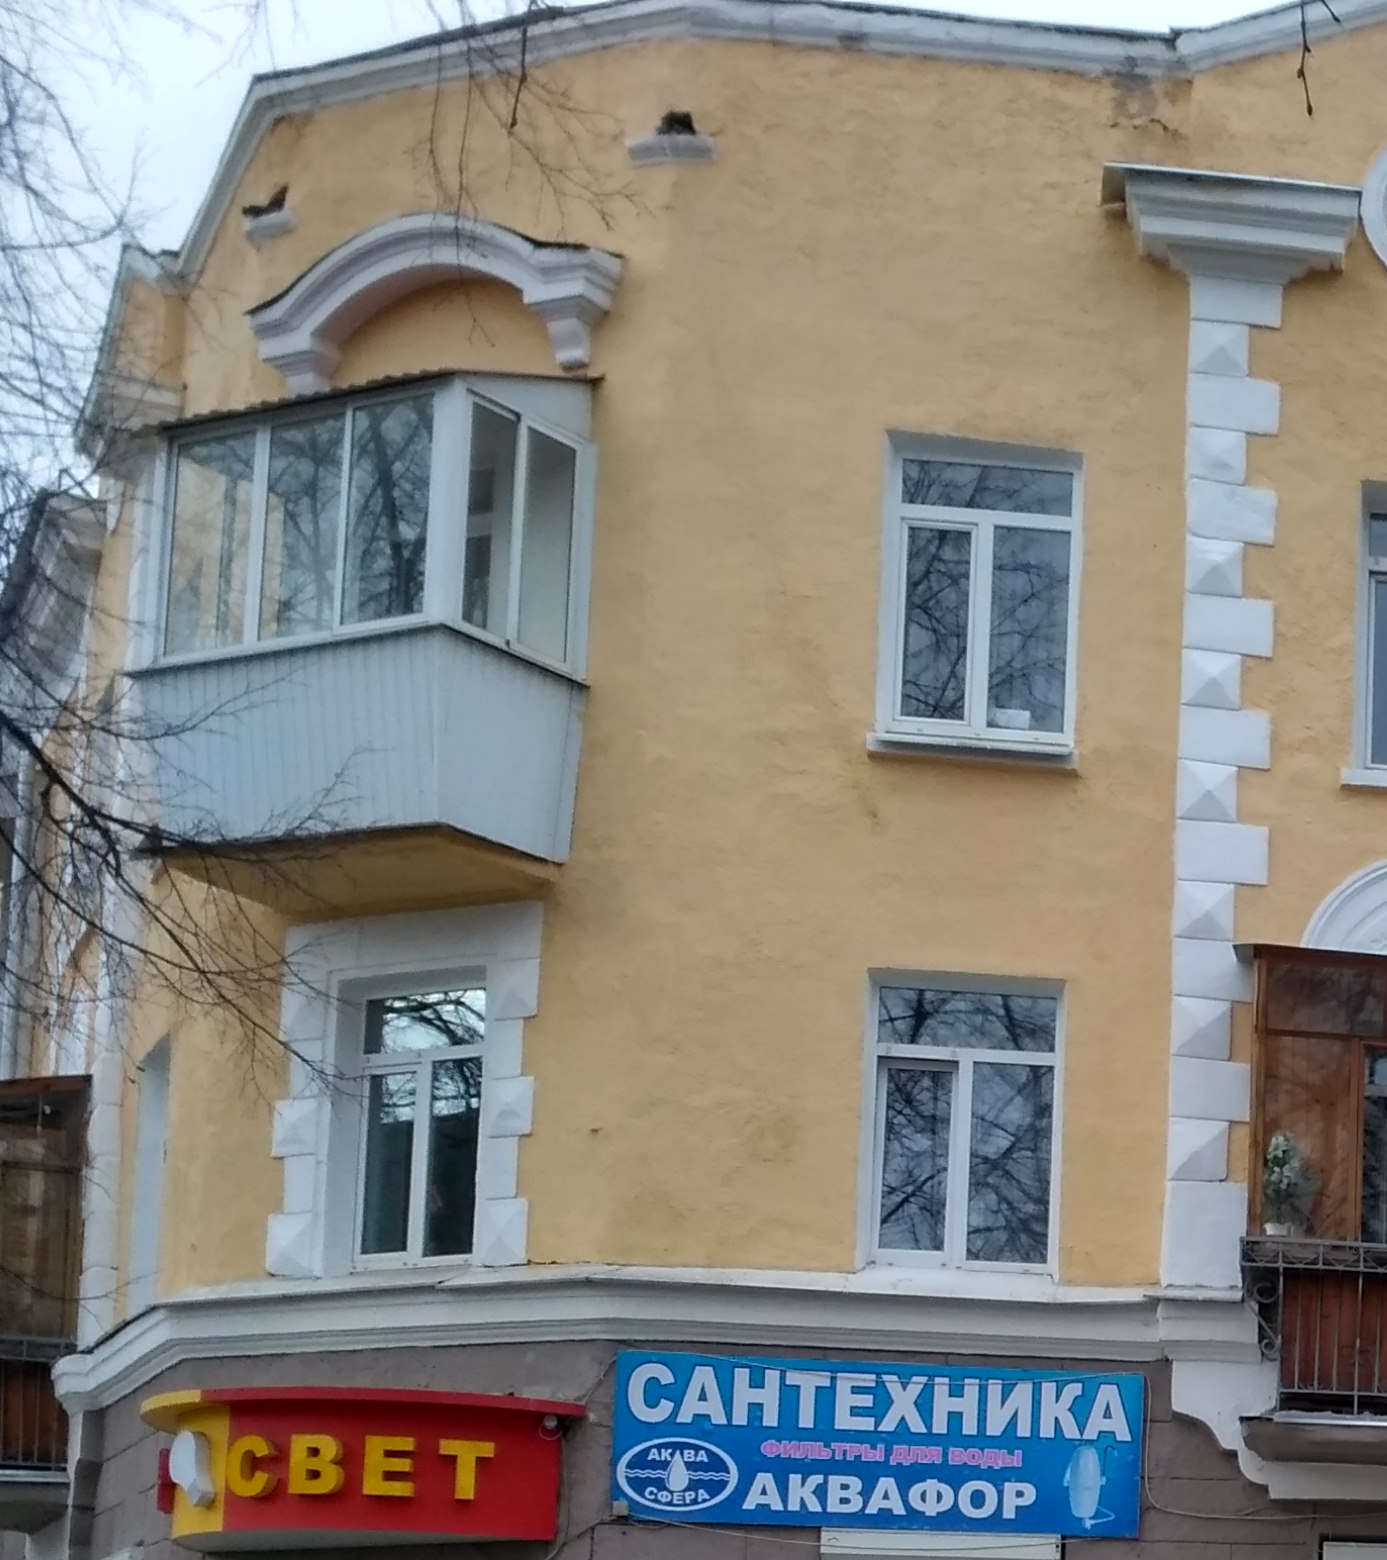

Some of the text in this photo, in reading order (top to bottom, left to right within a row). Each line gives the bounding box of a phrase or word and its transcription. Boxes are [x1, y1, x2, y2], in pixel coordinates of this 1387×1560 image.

[627, 1362, 1131, 1442] САНТЕХНИКА
[228, 1433, 496, 1501] СВЕТ
[760, 1440, 1023, 1469] ФИЛЬТРЫ ДЛЯ ВОДЫ
[644, 1487, 711, 1504] СФЕРА
[742, 1472, 1037, 1520] АКВАФОР
